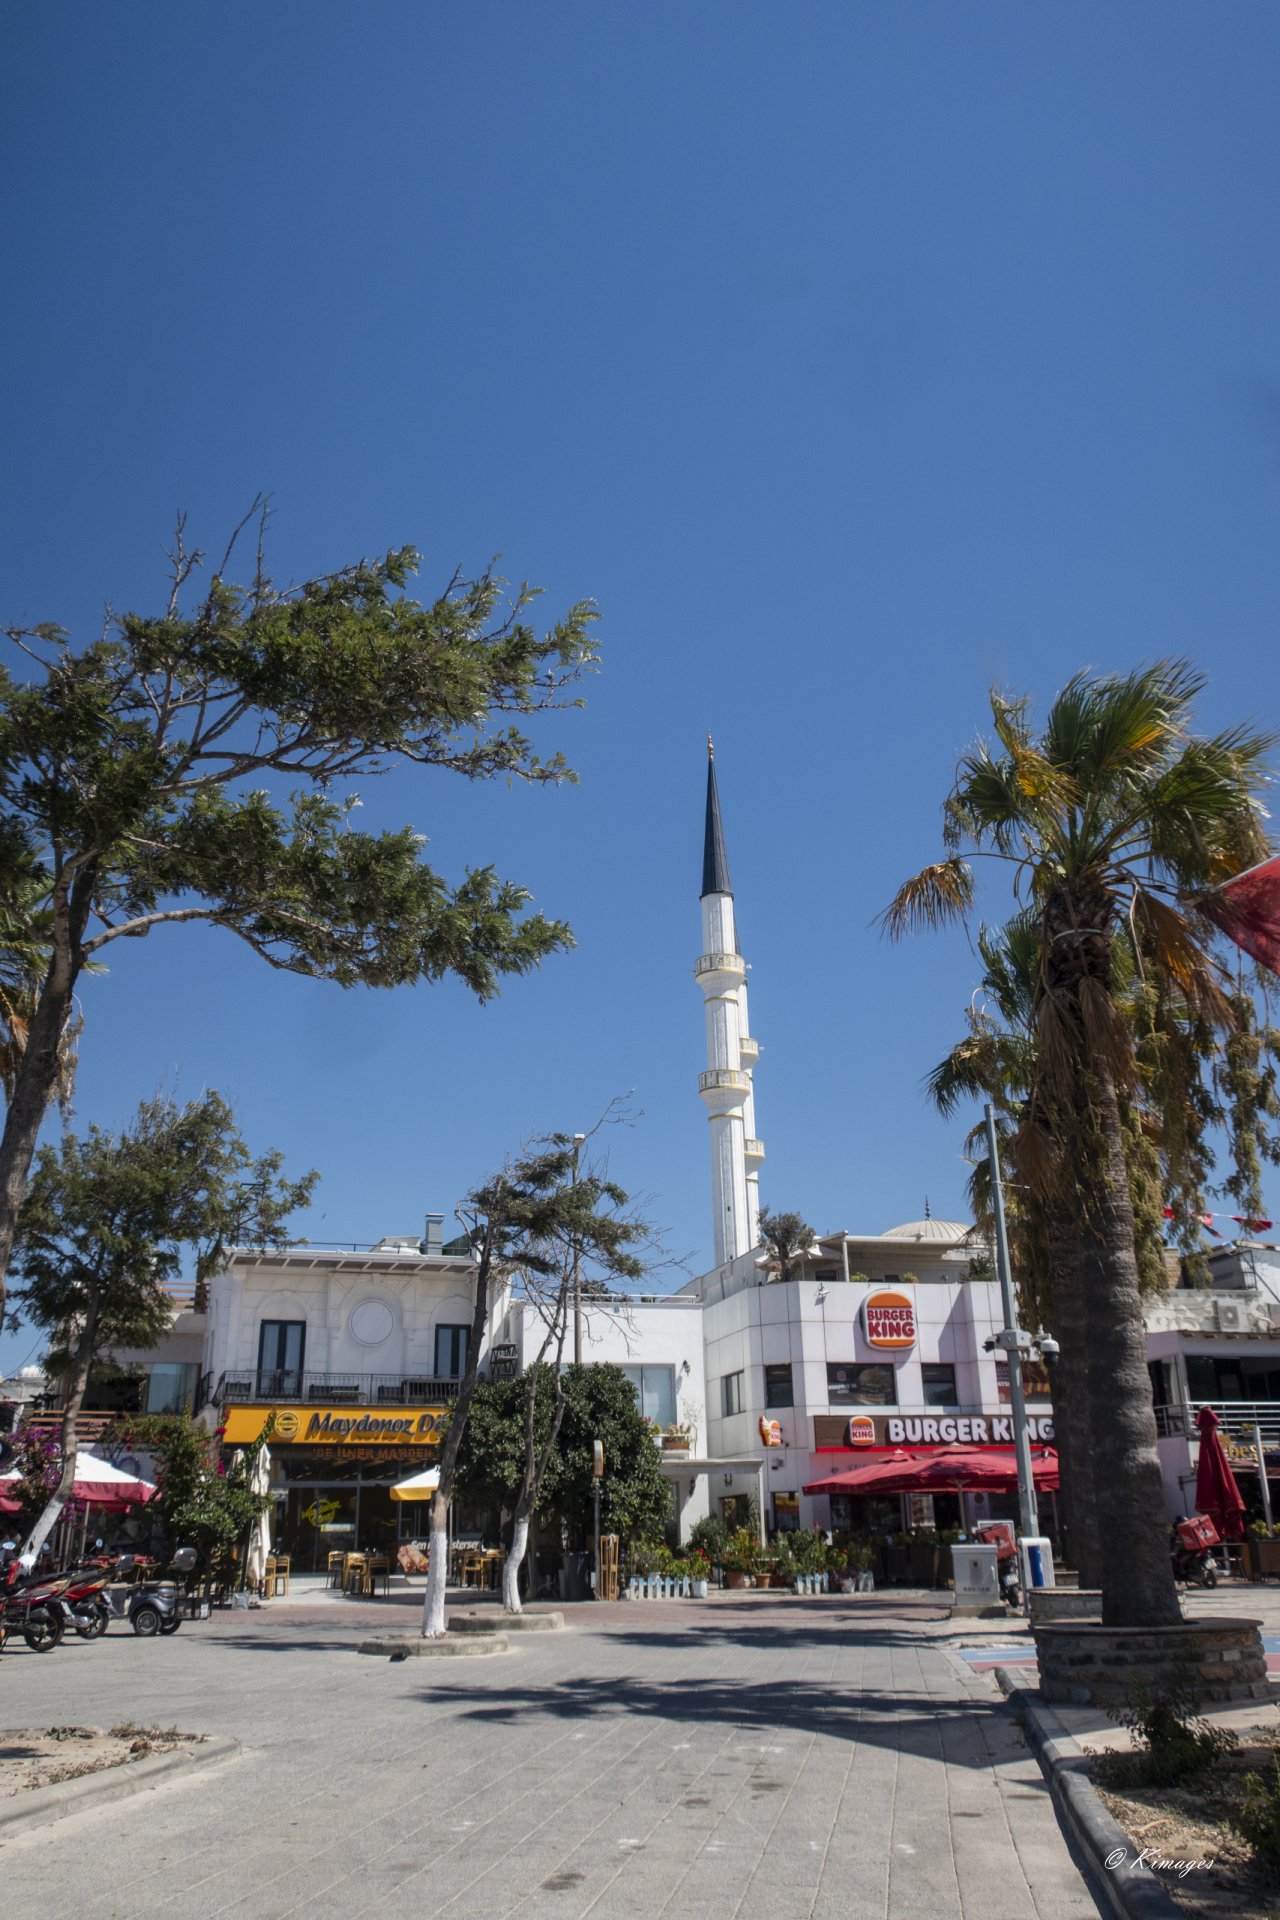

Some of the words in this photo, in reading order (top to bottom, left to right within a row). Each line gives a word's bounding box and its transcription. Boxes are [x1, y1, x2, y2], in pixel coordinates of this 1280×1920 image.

[867, 1309, 914, 1321] BURGER
[868, 1321, 915, 1338] KING
[310, 1412, 415, 1437] Maydonoz
[888, 1418, 989, 1443] BURGER
[852, 1430, 873, 1439] KING
